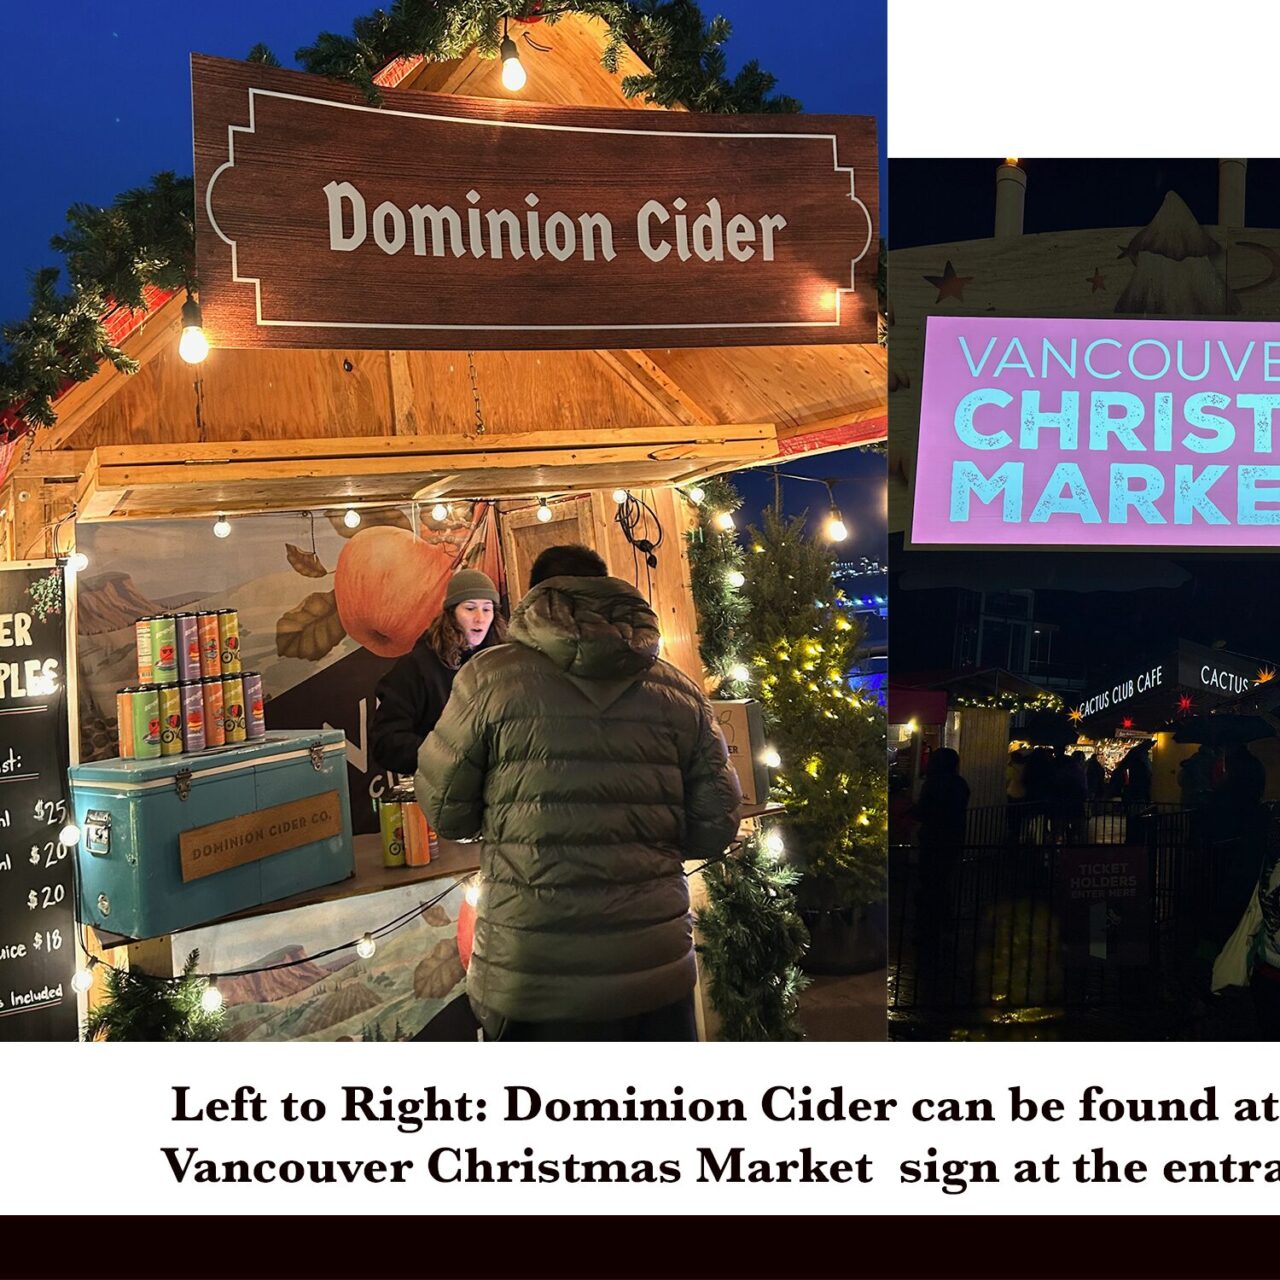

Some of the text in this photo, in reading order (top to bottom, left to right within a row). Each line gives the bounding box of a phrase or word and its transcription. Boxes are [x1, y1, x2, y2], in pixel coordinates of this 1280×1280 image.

[323, 180, 787, 262] Dominion Cider
[1079, 665, 1163, 719] CACTUS CLUB CAFE
[1200, 665, 1249, 694] CACTUS
[0, 747, 21, 773] st:
[33, 799, 67, 826] $25
[192, 810, 332, 861] DOMINION CIDER CO.
[29, 842, 68, 869] $20
[1077, 863, 1129, 875] TICKET
[1070, 876, 1137, 889] HOLDERS
[27, 884, 65, 911] $20
[33, 928, 62, 953] $18
[10, 983, 64, 1006] Included
